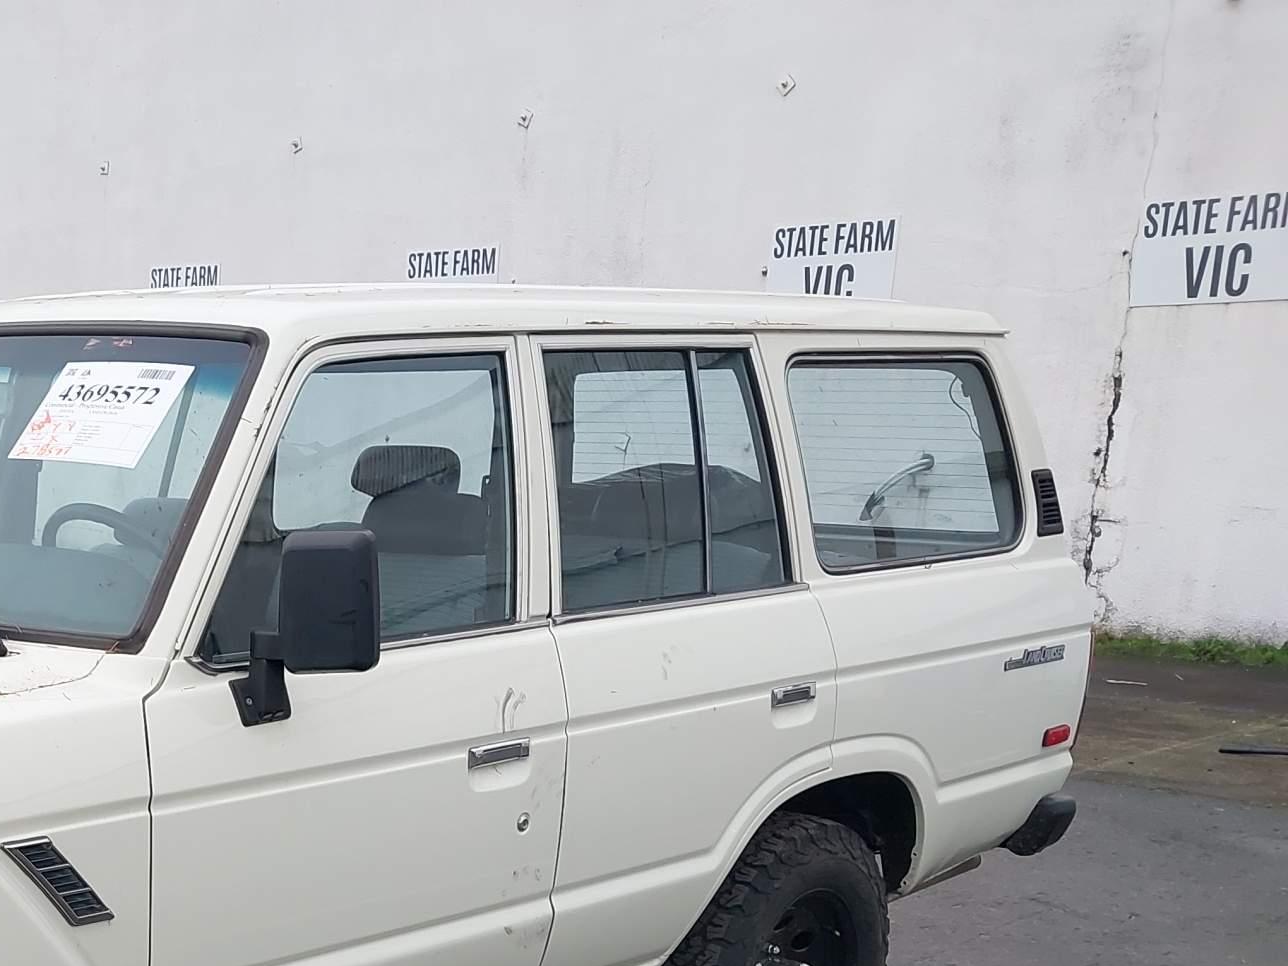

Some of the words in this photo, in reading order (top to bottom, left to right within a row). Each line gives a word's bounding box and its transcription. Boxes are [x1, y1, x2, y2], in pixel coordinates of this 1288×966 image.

[1144, 198, 1221, 238] STATE
[1226, 191, 1288, 233] FAR
[774, 224, 830, 259] STATE
[834, 219, 896, 254] FARM
[150, 267, 182, 289] STATE
[185, 265, 218, 287] FARM
[407, 251, 450, 279] STATE
[452, 247, 496, 276] FARM
[804, 263, 855, 297] VIC
[1185, 242, 1253, 298] VIC
[58, 384, 160, 405] 43695572
